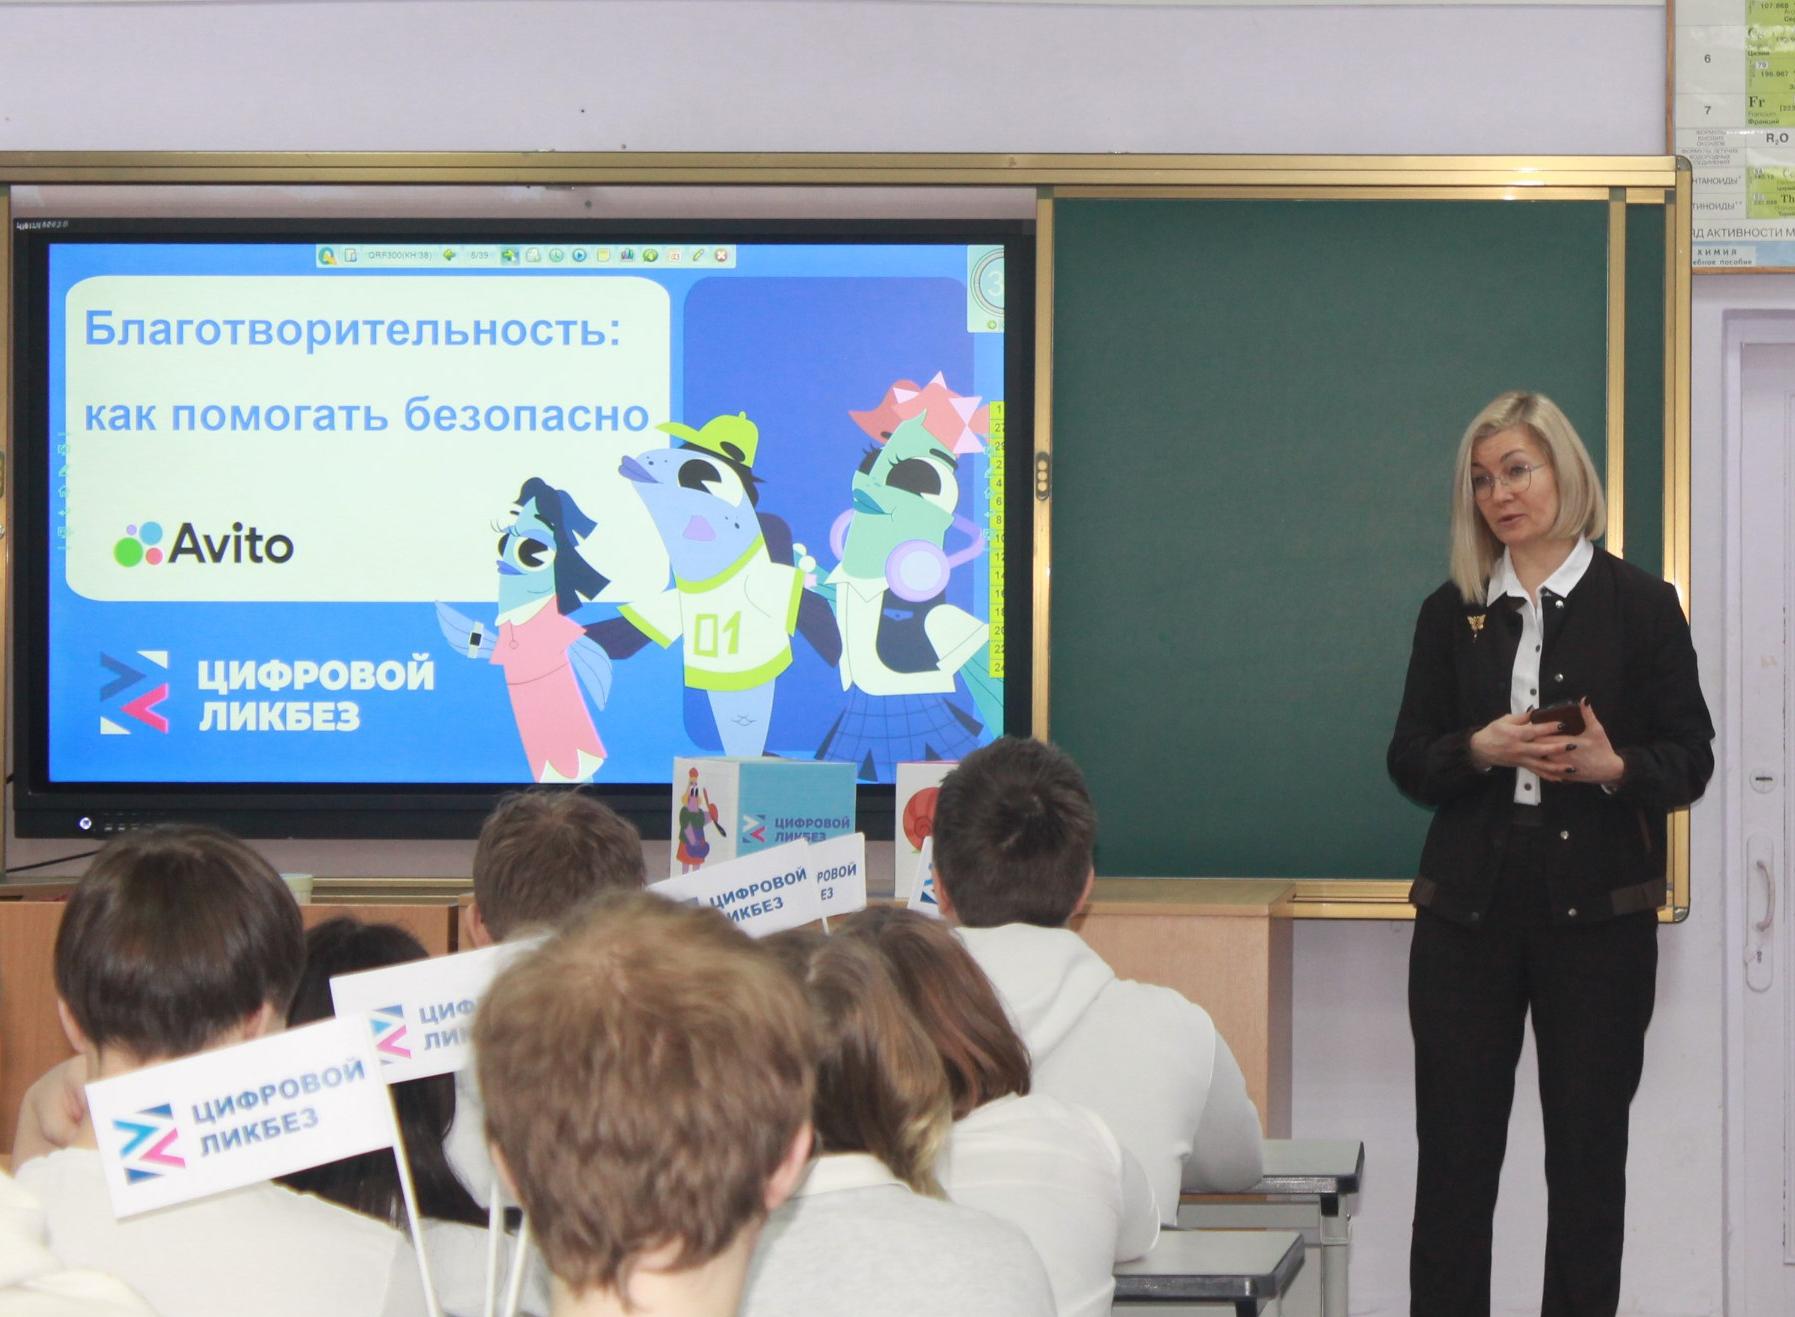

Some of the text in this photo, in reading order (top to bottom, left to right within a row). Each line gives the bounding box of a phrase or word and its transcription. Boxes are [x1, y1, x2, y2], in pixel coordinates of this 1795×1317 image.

[1704, 54, 1711, 63] 6
[1704, 105, 1711, 115] 7
[1749, 95, 1766, 108] Fr
[1707, 227, 1783, 239] АКТИВНОСТИ
[86, 309, 621, 353] Благотворительность:
[85, 396, 650, 431] как помогать безопасно
[996, 459, 1002, 469] 2
[996, 478, 1002, 488] 4
[996, 497, 1002, 506] 6
[996, 515, 1002, 525] 8
[168, 522, 294, 564] Avito
[694, 611, 741, 658] 01
[198, 652, 435, 695] ЦИФРОВОЙ
[199, 700, 360, 731] ЛИКБЕЗ
[775, 815, 850, 830] ЦИФРОВОЙ
[816, 861, 857, 884] РОВОЙ
[709, 867, 807, 910] ЦИФРОВОЙ
[820, 887, 834, 901] ЕЗ
[192, 1057, 365, 1125] ЦИФРОВОЙ
[201, 1107, 319, 1157] ЛИКБЕЗ
